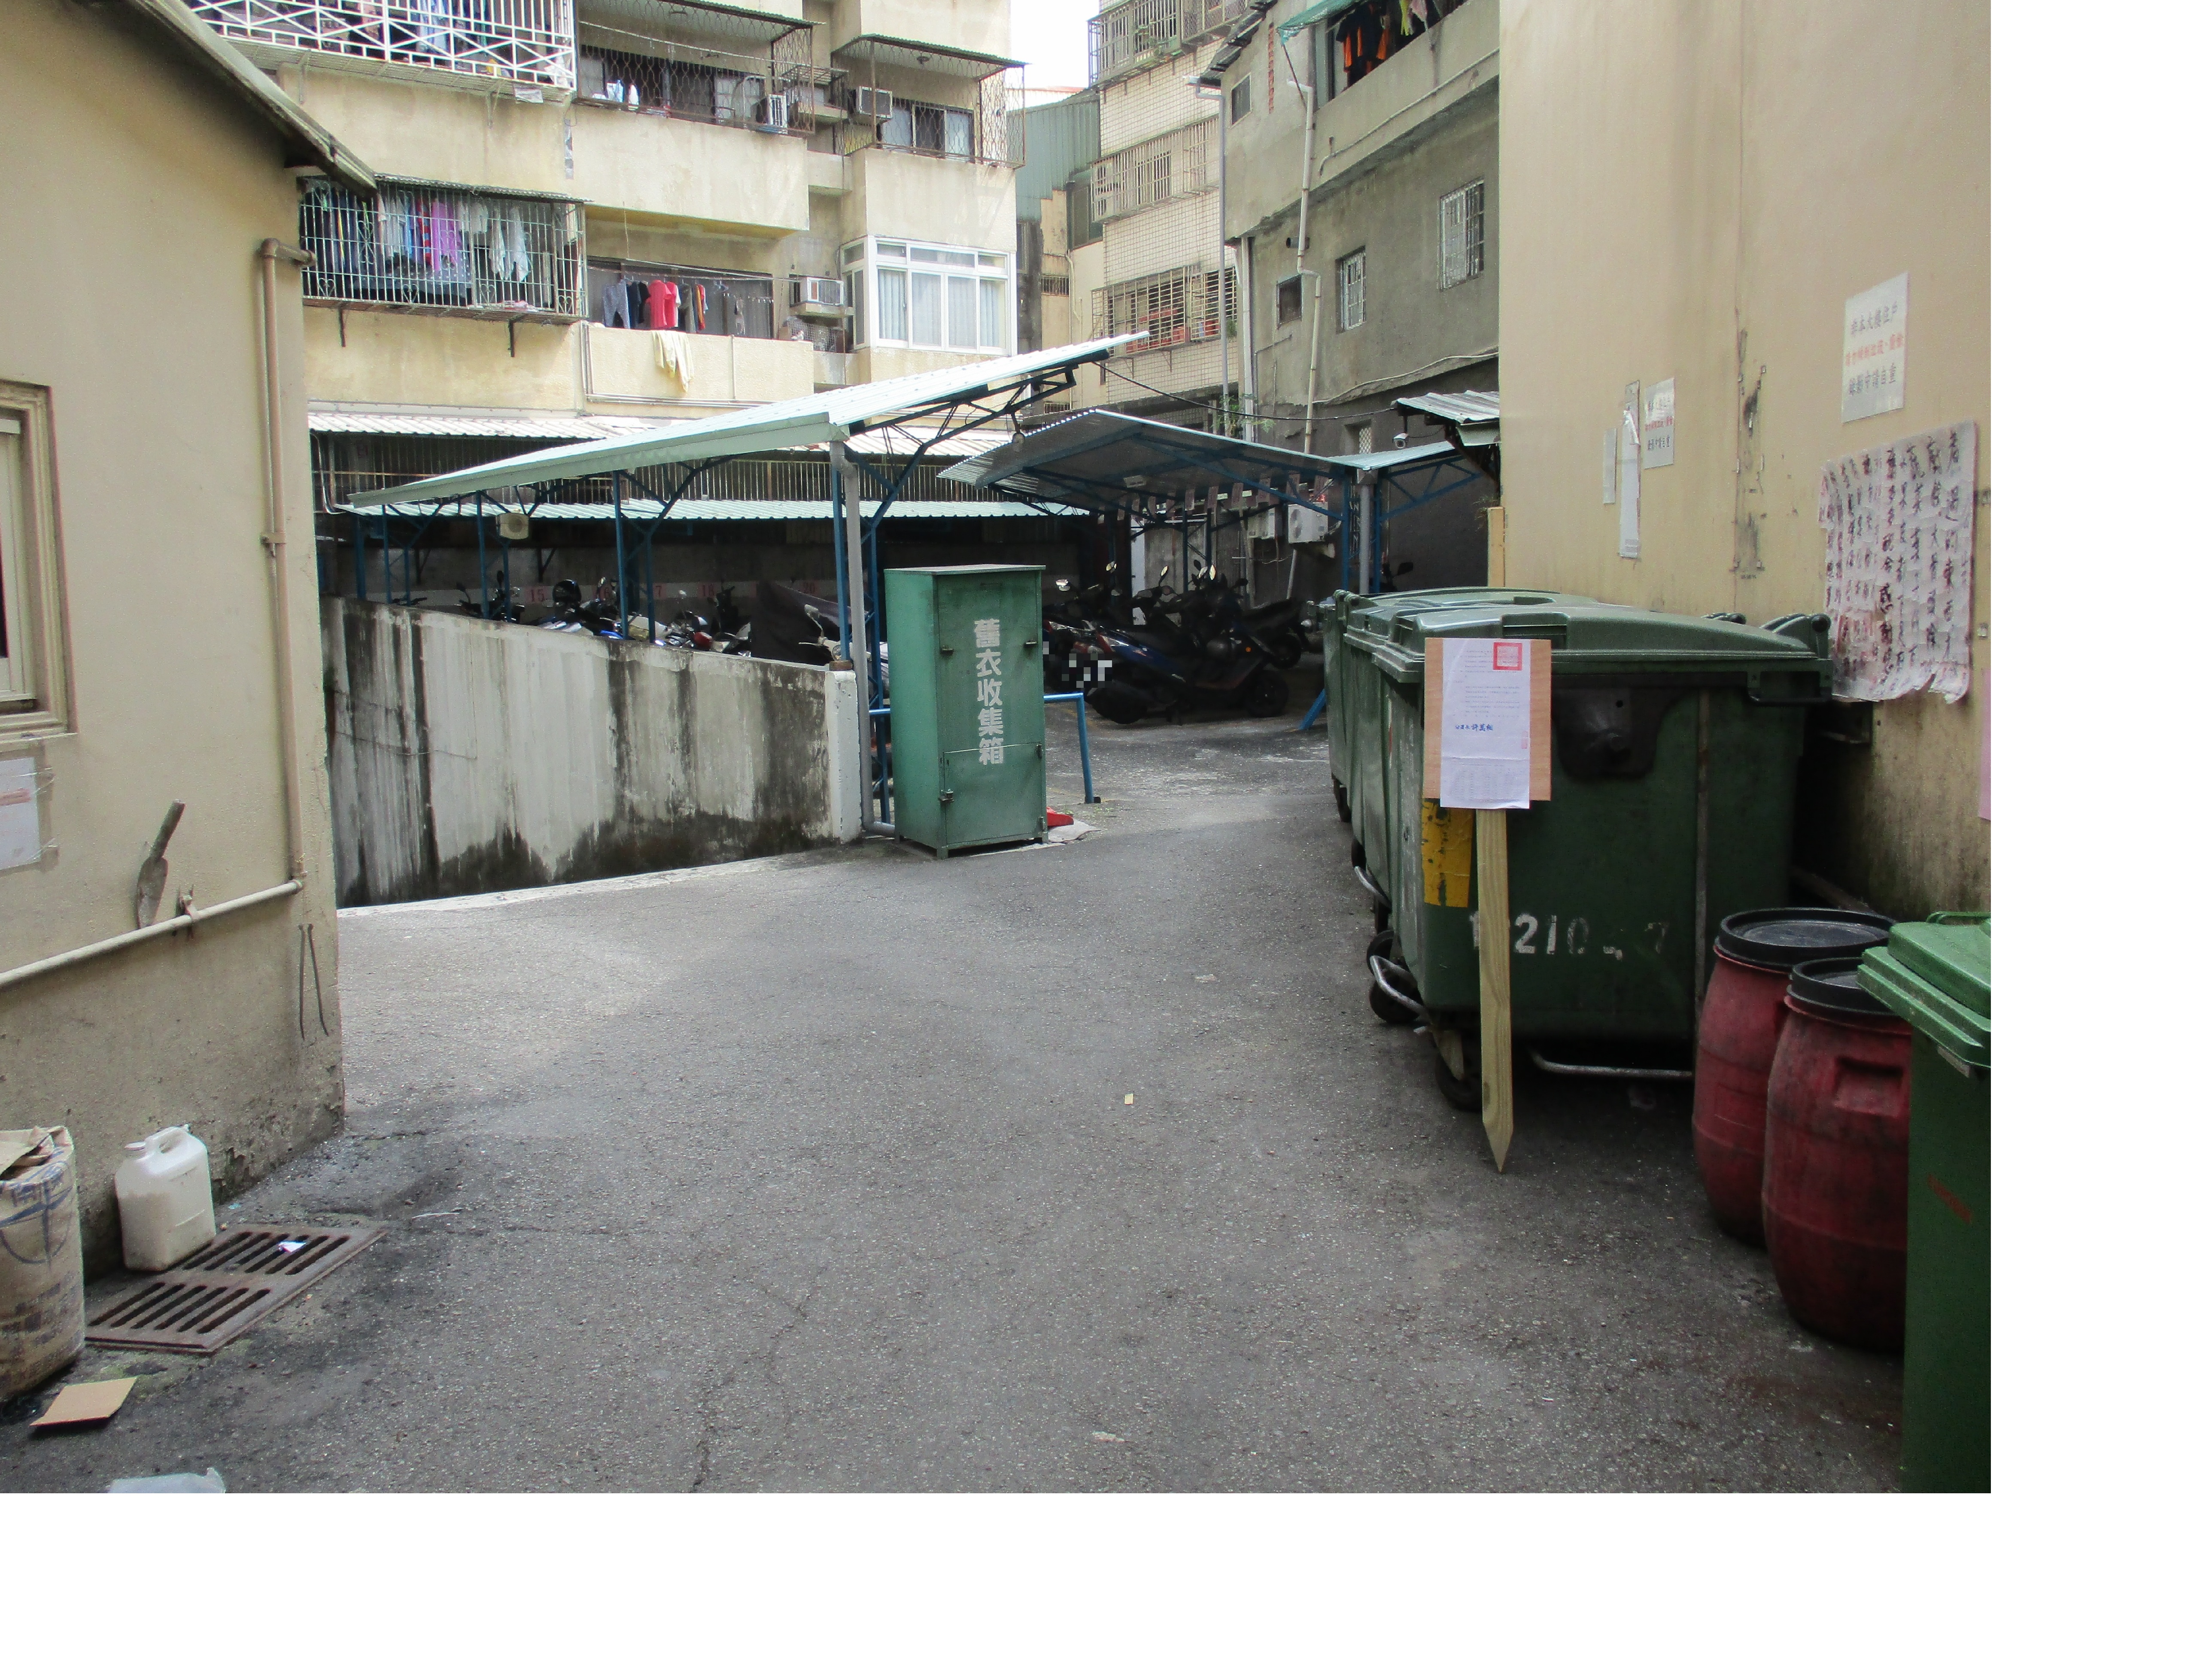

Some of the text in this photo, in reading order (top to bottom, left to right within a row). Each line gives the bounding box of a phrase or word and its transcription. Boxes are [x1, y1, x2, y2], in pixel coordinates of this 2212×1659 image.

[530, 588, 545, 602] 15
[974, 618, 1004, 766] 舊衣收集箱
